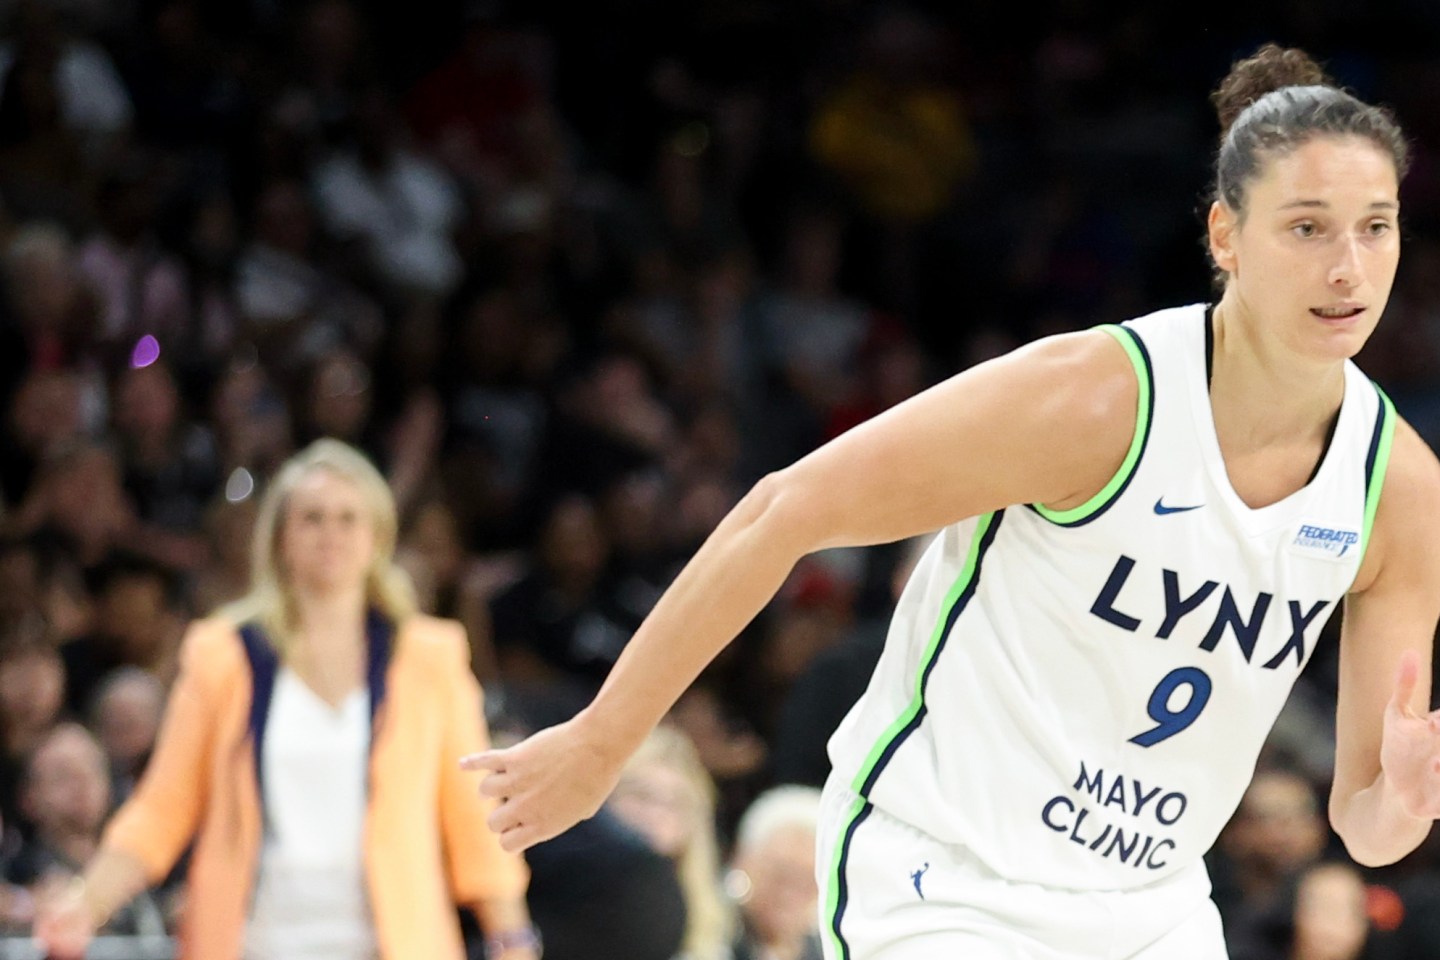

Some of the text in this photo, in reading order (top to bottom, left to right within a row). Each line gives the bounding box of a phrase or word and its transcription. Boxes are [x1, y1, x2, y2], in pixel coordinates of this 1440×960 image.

[1090, 555, 1330, 670] LYNX
[1128, 666, 1212, 748] 9
[1042, 796, 1175, 870] CLINIC
[1073, 761, 1187, 828] MAYO
